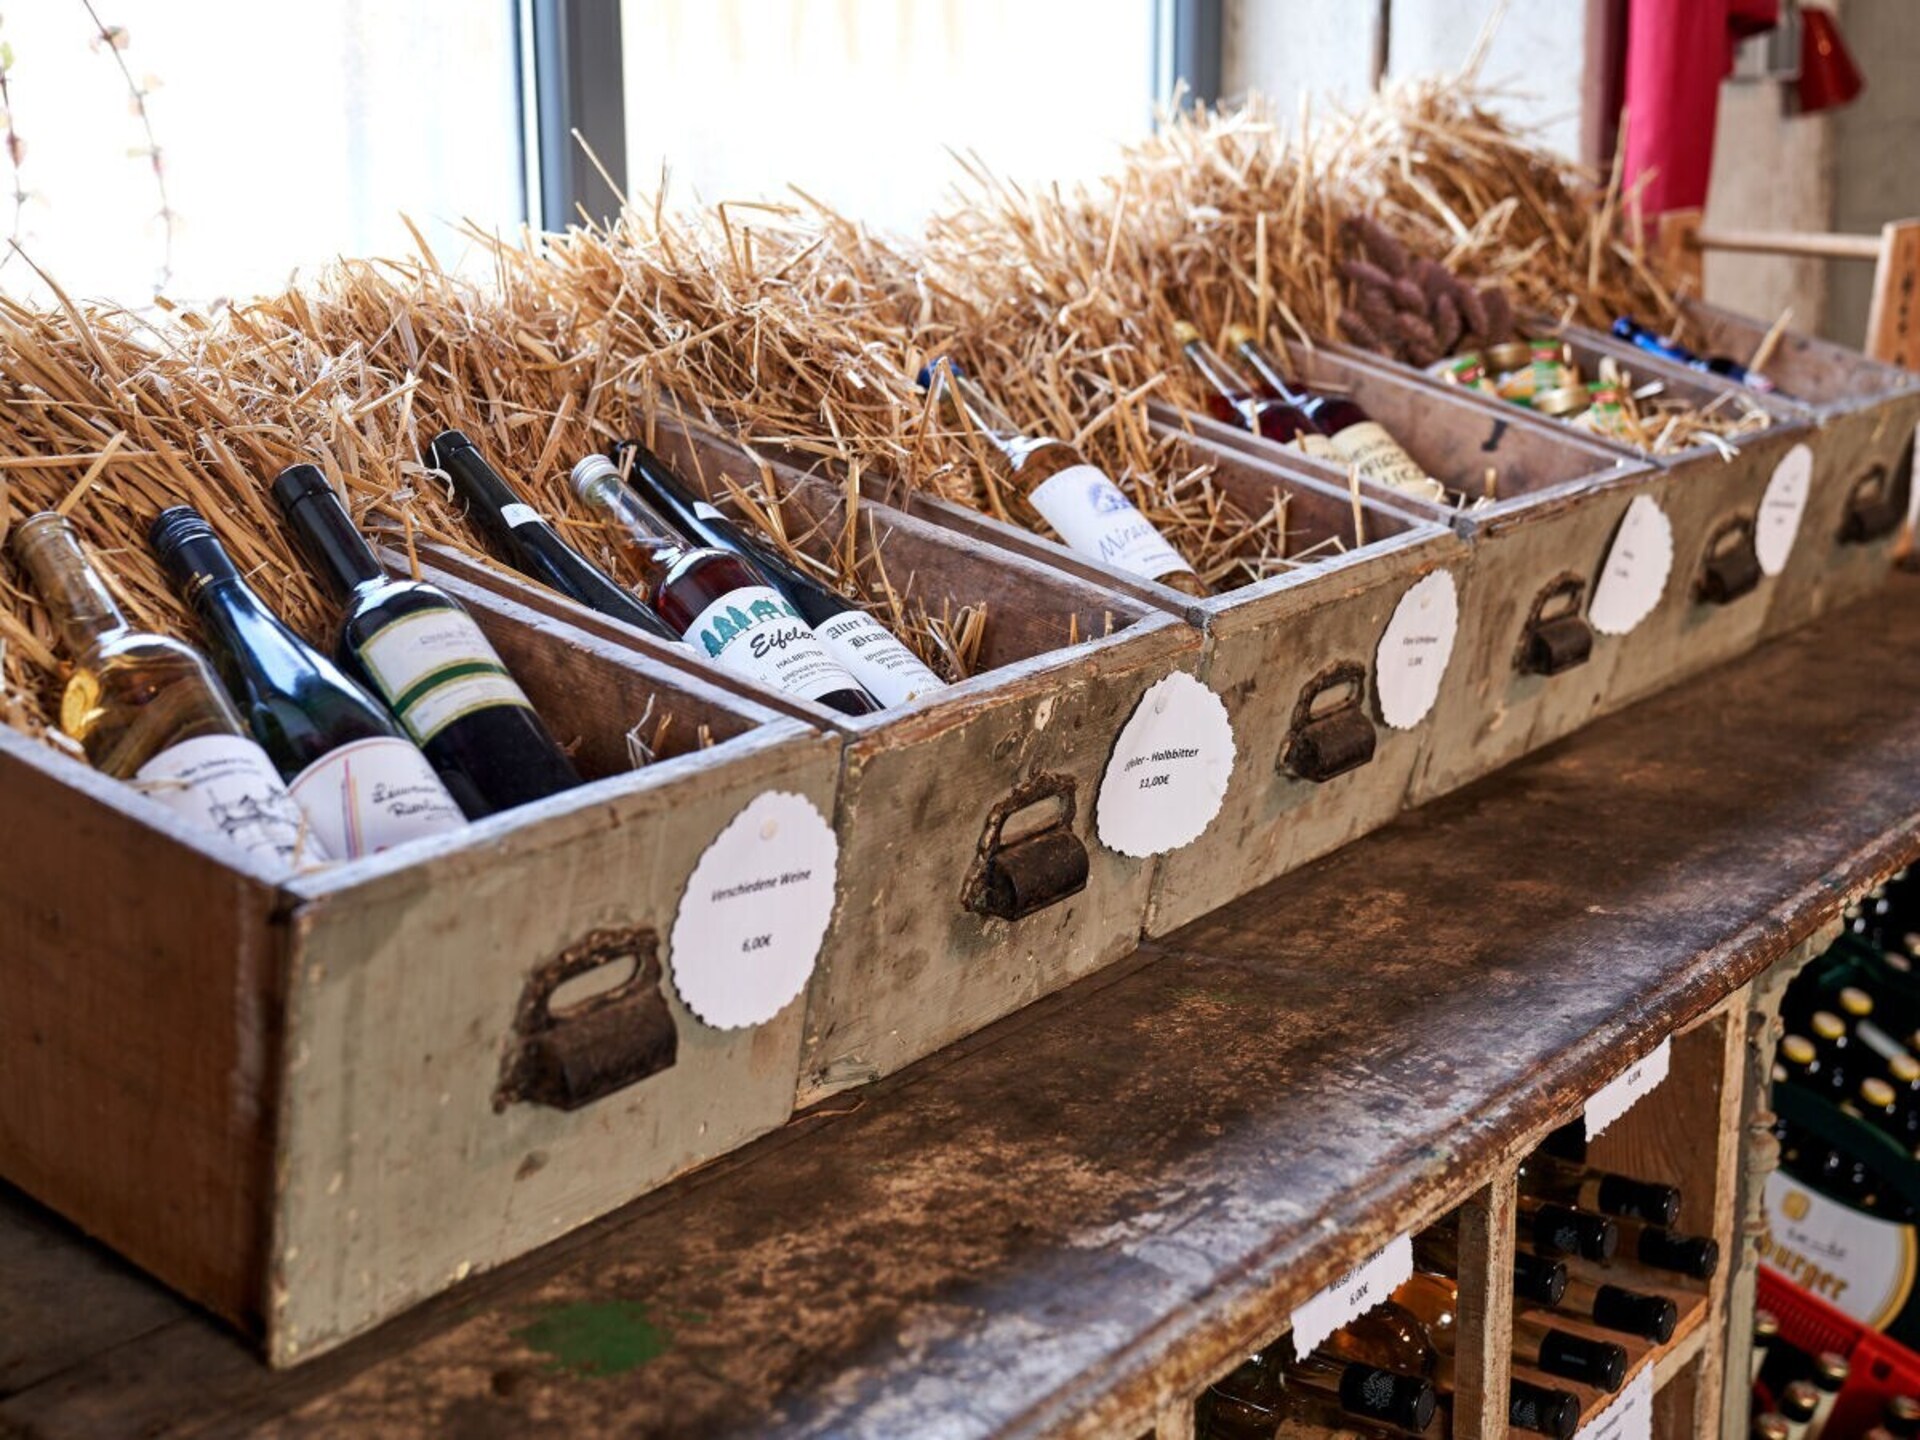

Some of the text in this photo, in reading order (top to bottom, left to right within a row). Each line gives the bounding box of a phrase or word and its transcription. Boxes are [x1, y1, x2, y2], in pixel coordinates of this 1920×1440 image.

[1151, 748, 1200, 762] Halbbitter
[1139, 774, 1171, 789] 11,00€
[711, 869, 812, 903] Verschiedene Weine
[741, 933, 773, 952] 6,00€
